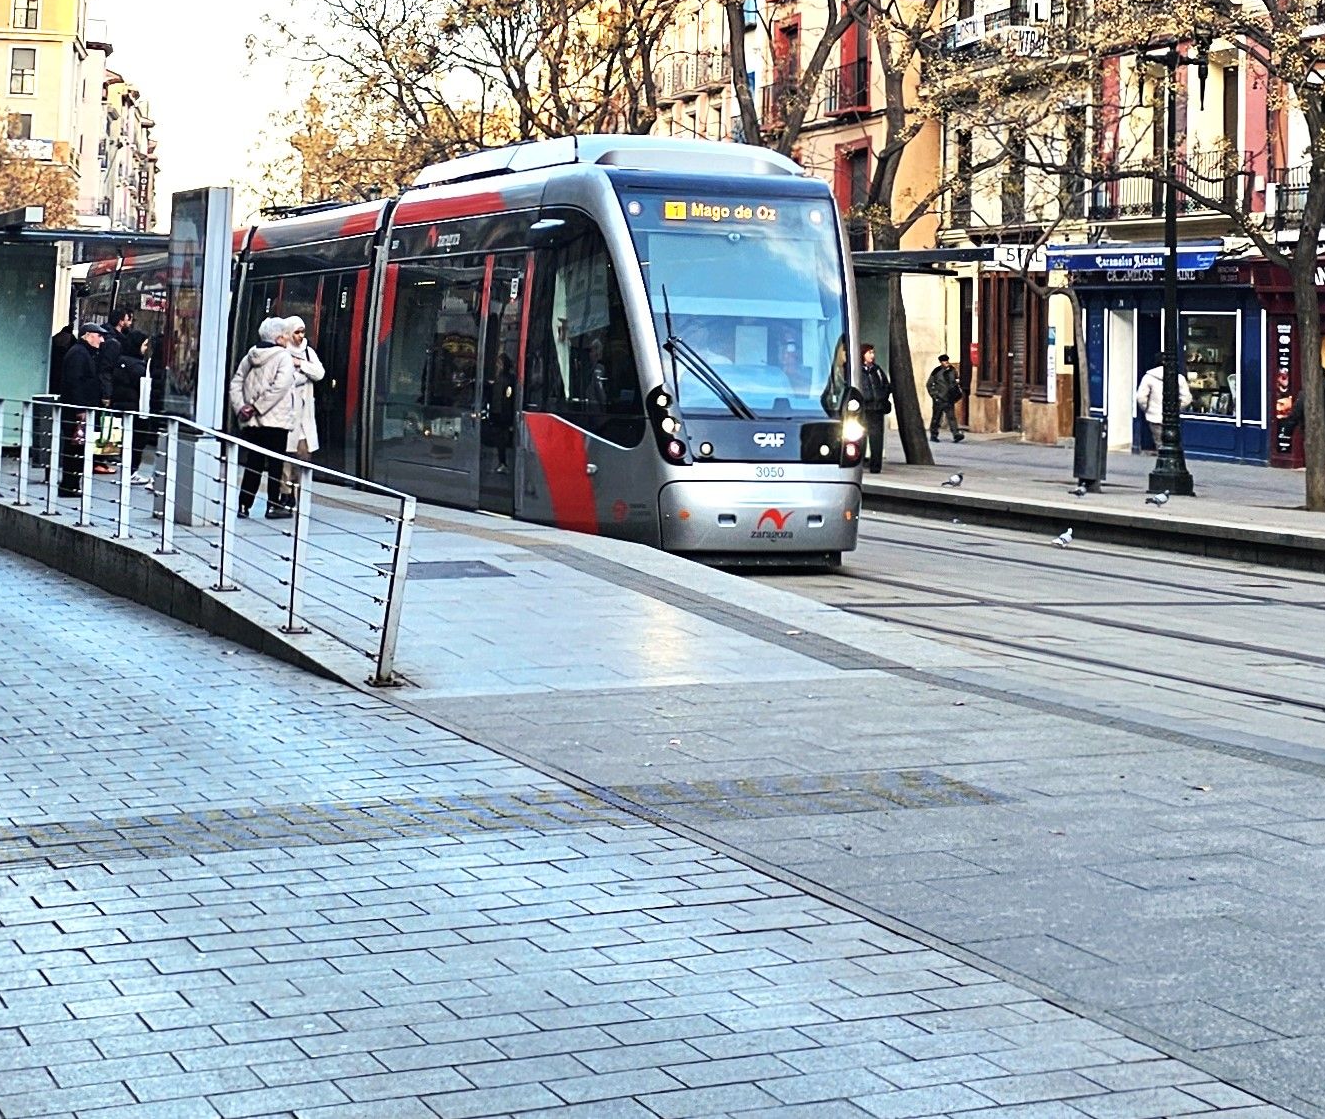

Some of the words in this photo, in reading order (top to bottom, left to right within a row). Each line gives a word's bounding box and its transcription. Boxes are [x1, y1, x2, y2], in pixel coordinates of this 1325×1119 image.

[691, 202, 730, 222] Mago
[734, 205, 753, 219] de
[756, 205, 776, 221] Oz
[753, 432, 786, 448] CAF
[756, 466, 785, 478] 3050
[750, 530, 794, 543] zaragoza
